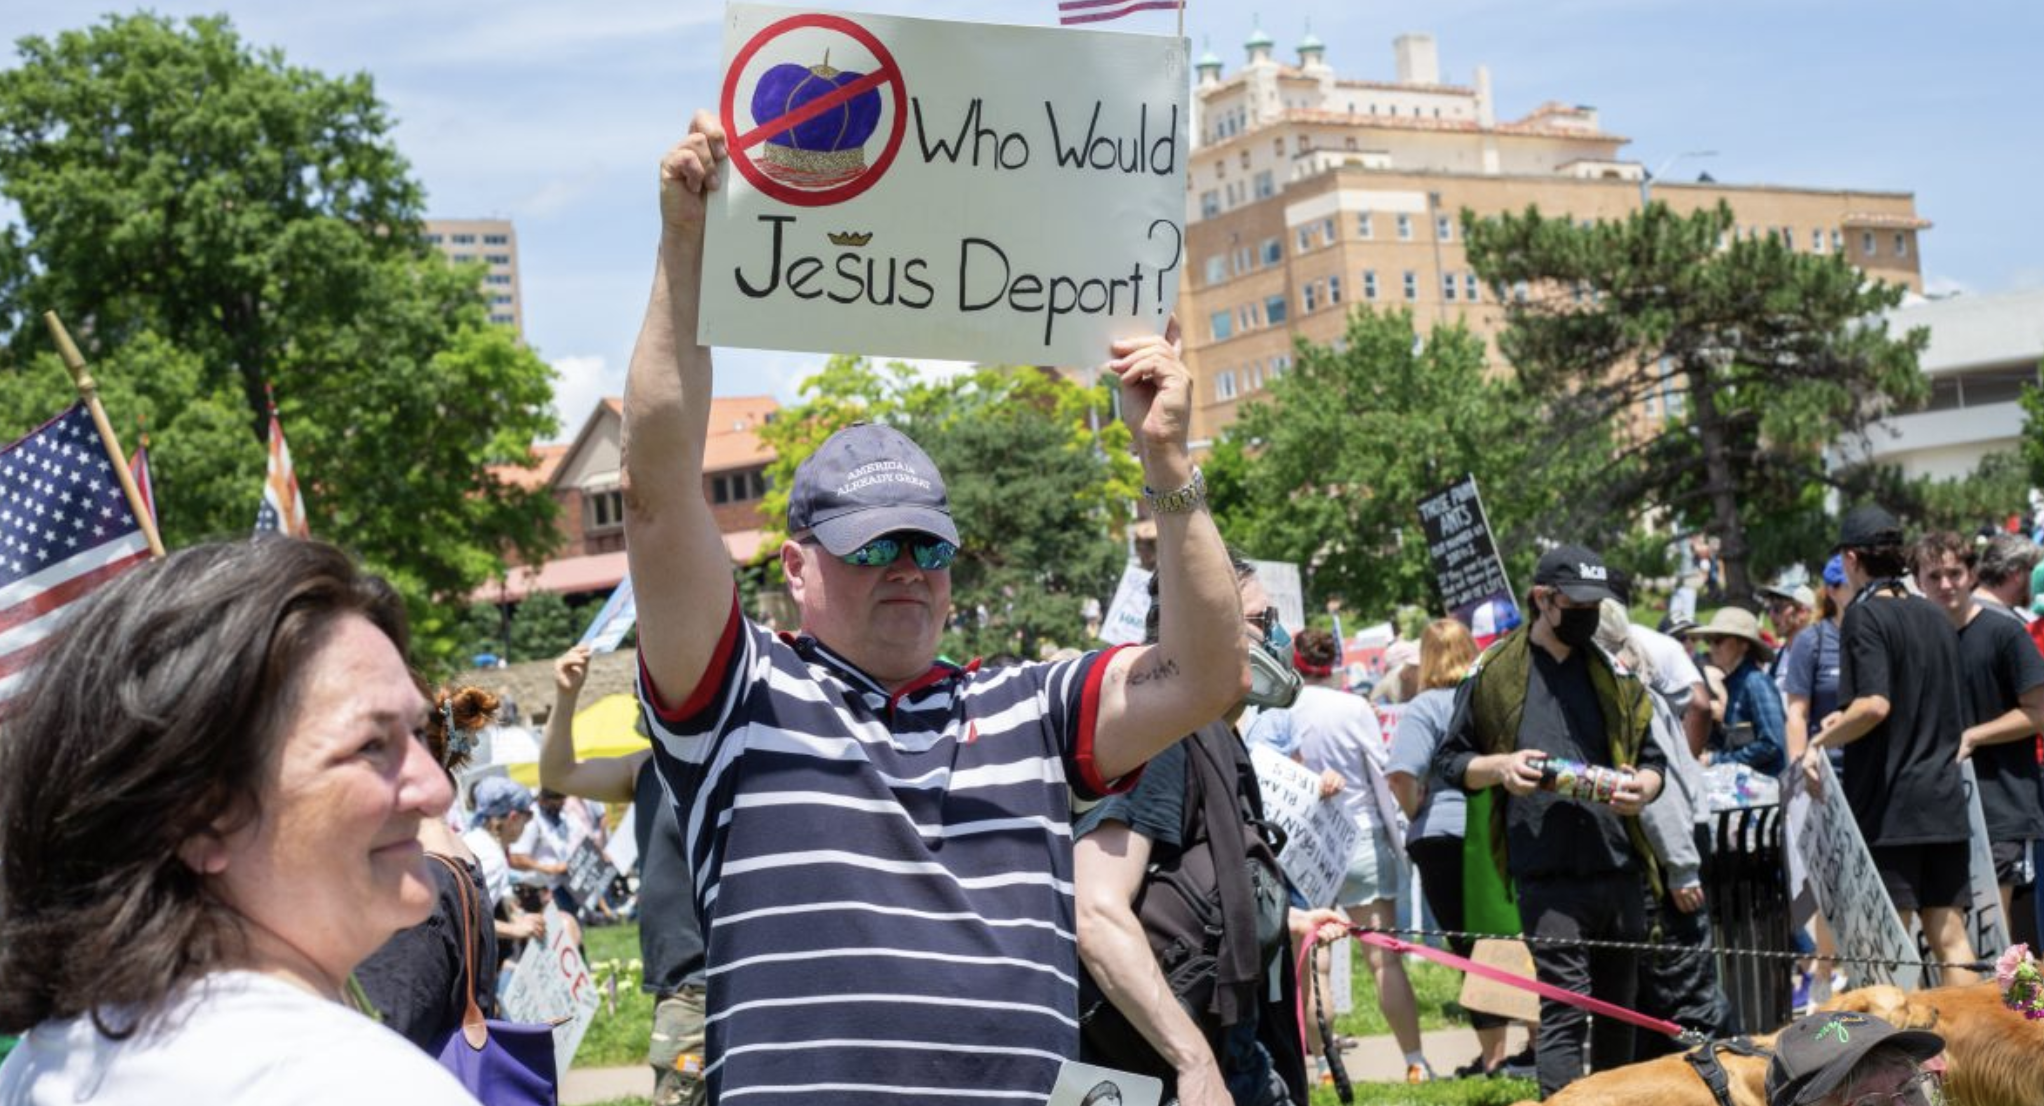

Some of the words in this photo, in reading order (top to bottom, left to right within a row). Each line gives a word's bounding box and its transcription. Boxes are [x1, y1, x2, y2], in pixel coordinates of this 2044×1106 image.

[911, 97, 1030, 170] Who
[1044, 100, 1178, 175] Would
[734, 215, 934, 310] Jesus
[959, 219, 1181, 346] Deport?
[836, 473, 893, 496] ALREADY
[894, 473, 932, 490] GREAT
[847, 460, 903, 480] AMERICA
[1440, 504, 1473, 537] ANTS
[1262, 799, 1341, 891] IMMIGRANTS
